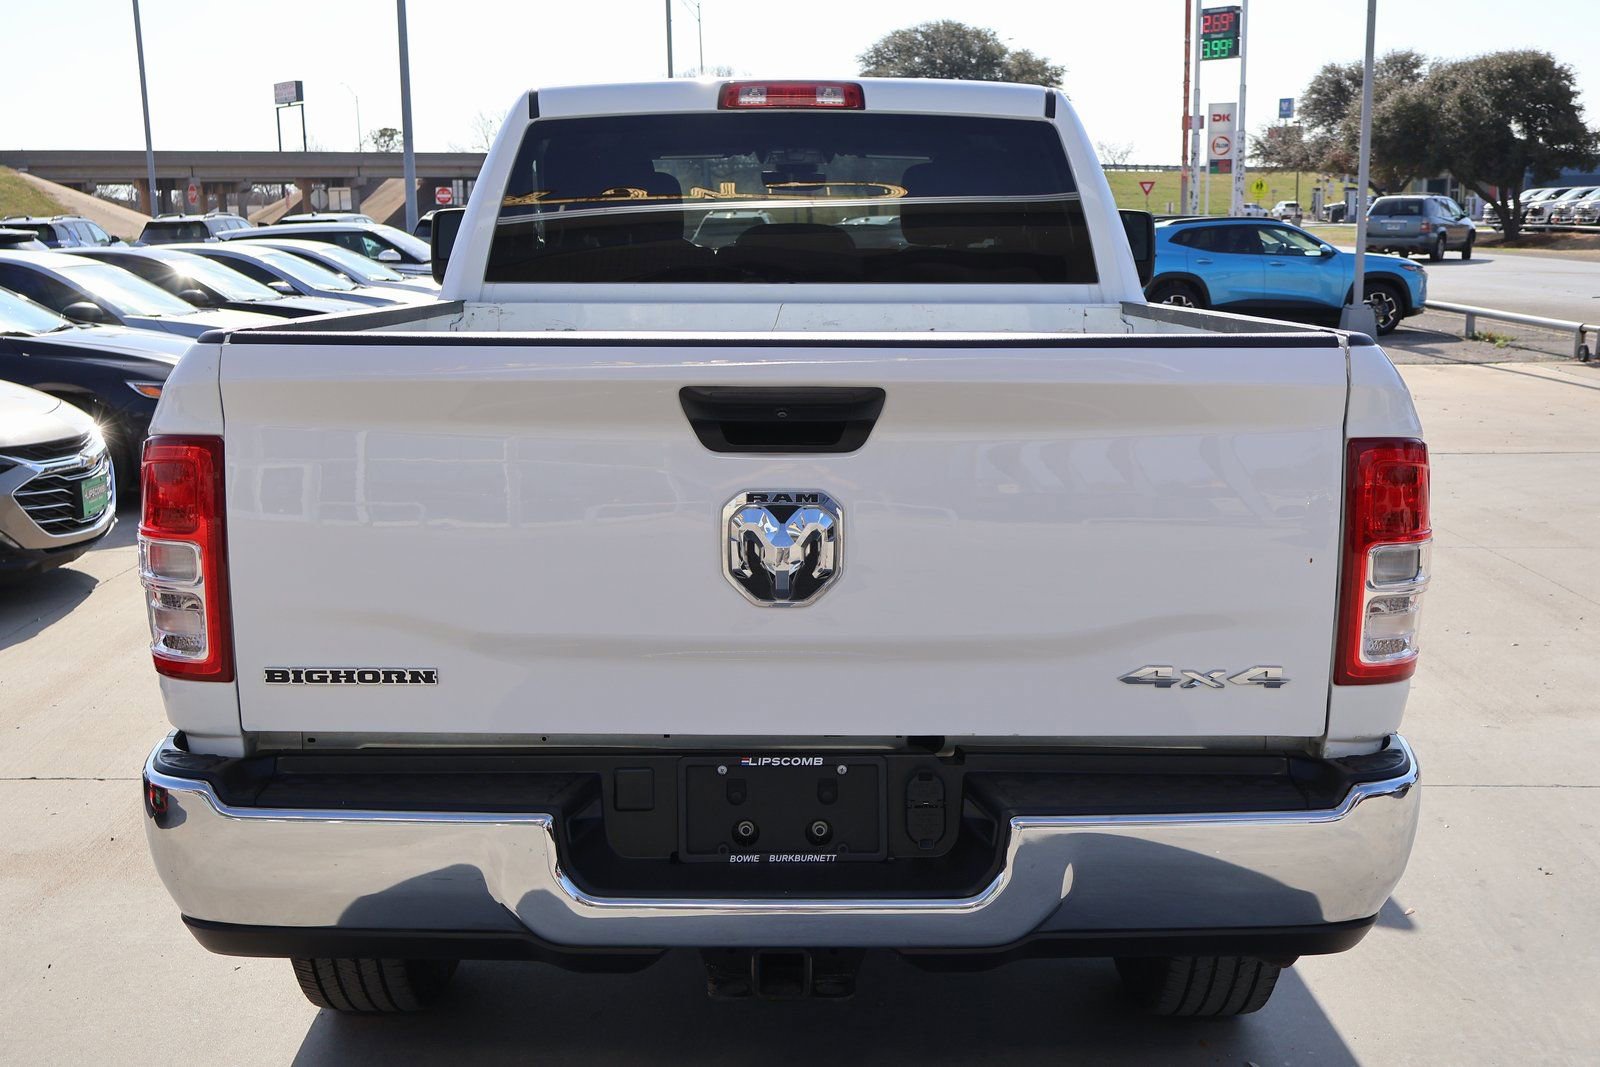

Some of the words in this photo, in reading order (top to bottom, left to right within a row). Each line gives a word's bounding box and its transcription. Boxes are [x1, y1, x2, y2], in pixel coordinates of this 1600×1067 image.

[1212, 113, 1231, 122] DK
[746, 493, 819, 503] RAM
[264, 667, 438, 685] BIGHORN
[748, 757, 824, 766] LIPSCOMB
[729, 854, 760, 863] BOWIE
[769, 854, 837, 862] BURKBURNETT
